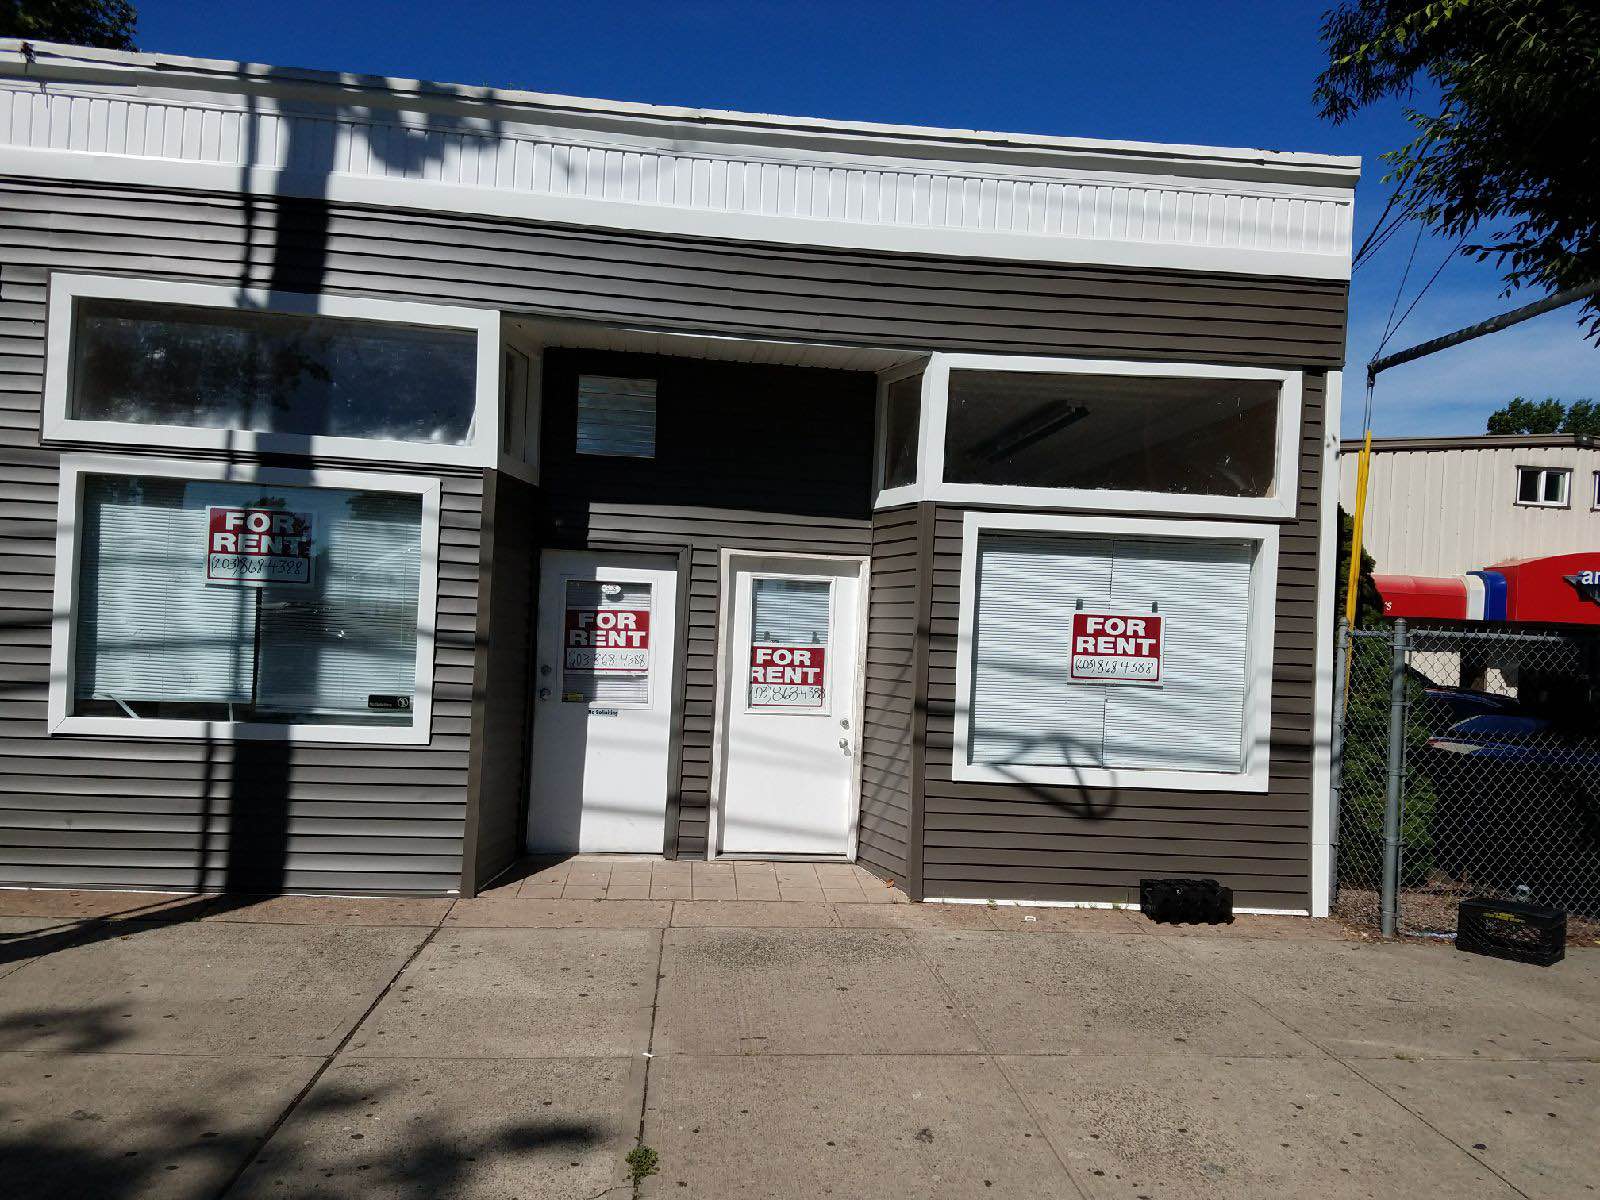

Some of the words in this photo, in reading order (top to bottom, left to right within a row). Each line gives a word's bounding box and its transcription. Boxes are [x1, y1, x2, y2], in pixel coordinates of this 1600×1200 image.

[225, 511, 296, 533] FOR
[213, 532, 307, 554] RENT
[578, 612, 637, 629] FOR
[1086, 617, 1146, 636] FOR
[569, 630, 646, 647] RENT
[1076, 636, 1157, 655] RENT
[756, 648, 811, 665] FOR
[751, 666, 821, 683] RENT
